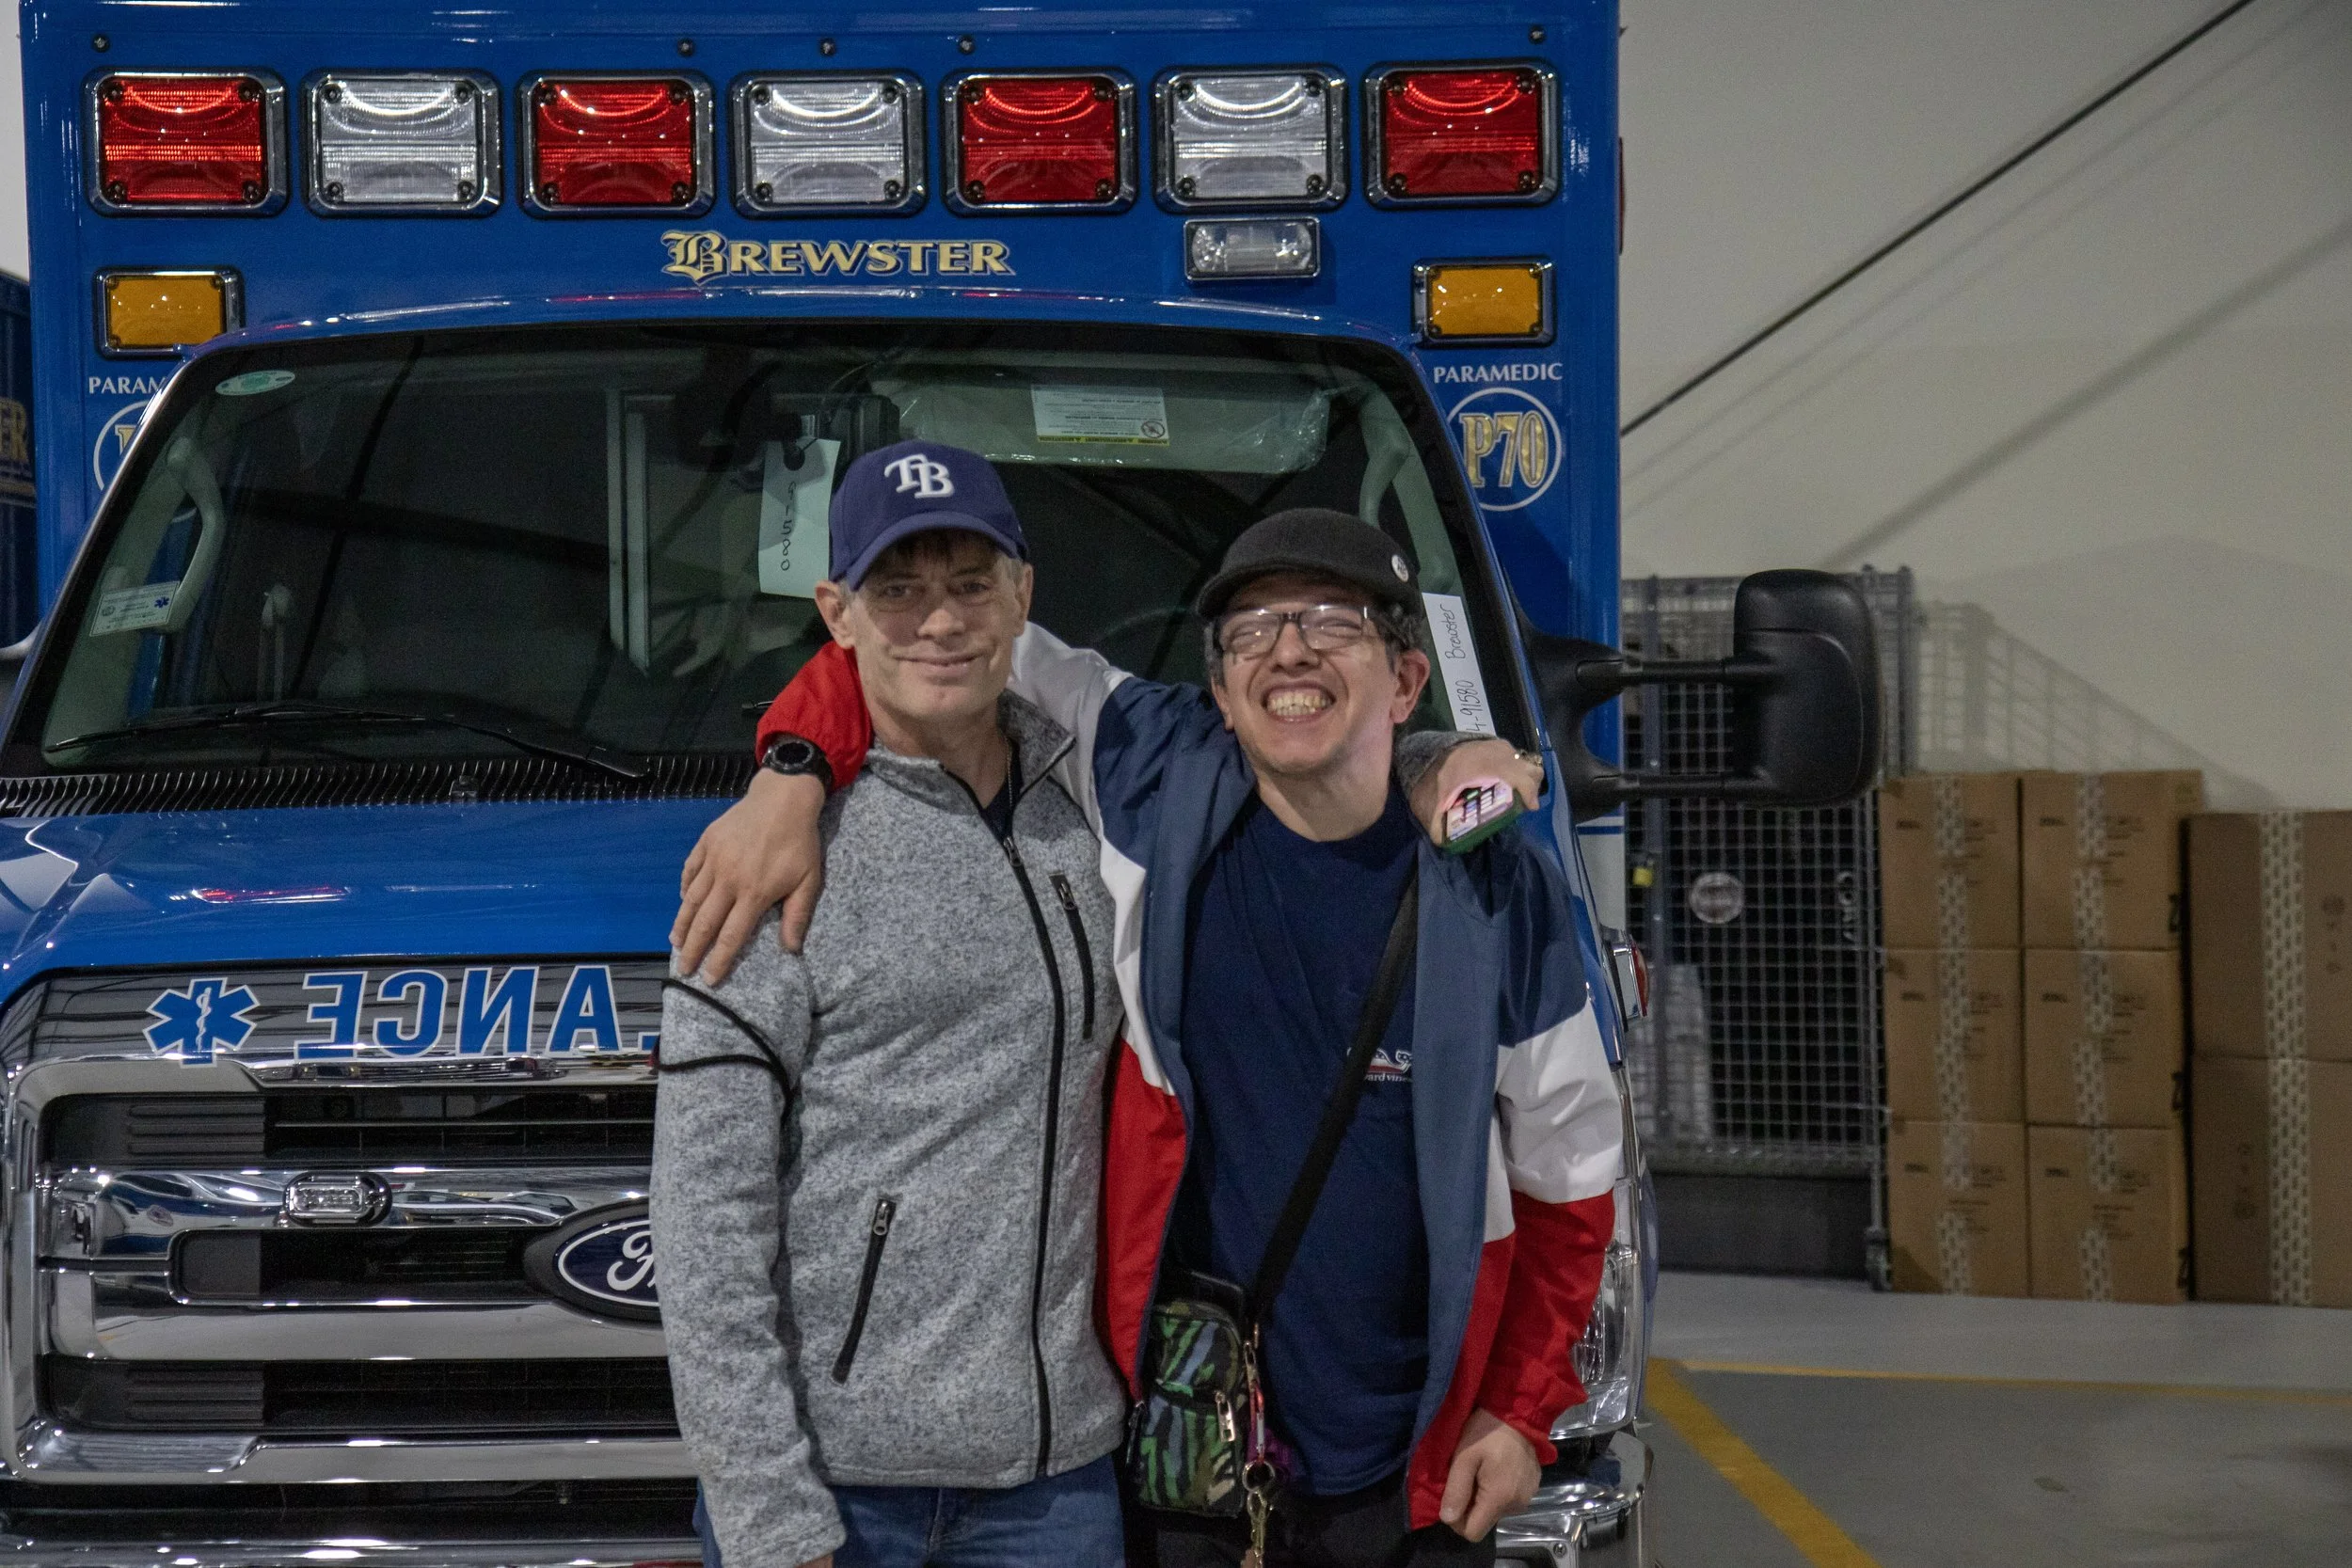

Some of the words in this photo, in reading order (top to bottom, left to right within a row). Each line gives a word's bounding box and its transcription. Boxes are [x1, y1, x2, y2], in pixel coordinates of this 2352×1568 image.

[660, 230, 1015, 286] BREWSTER
[1433, 362, 1564, 384] PARAMEDIC
[884, 453, 955, 499] TB
[1459, 410, 1549, 488] P70
[1439, 604, 1467, 659] Brewster
